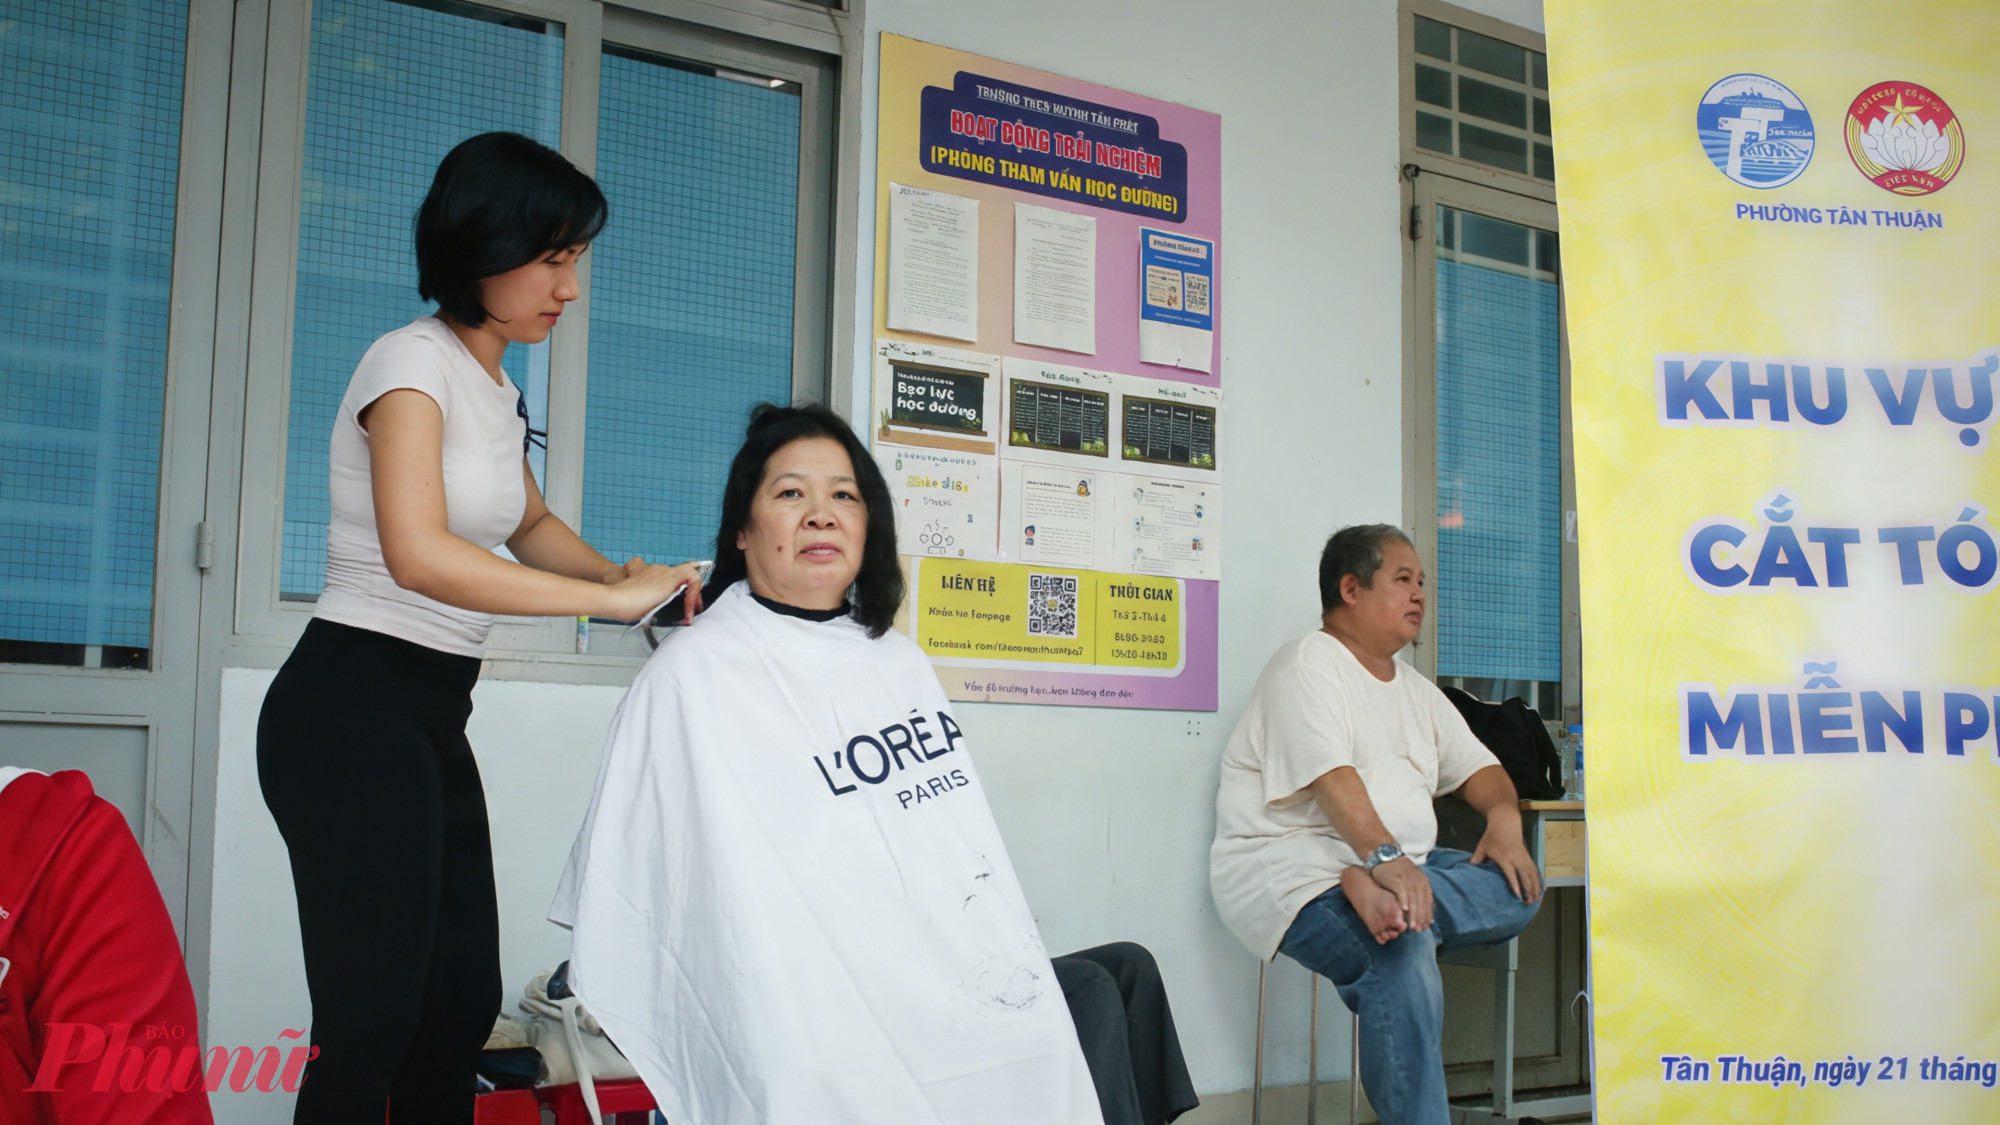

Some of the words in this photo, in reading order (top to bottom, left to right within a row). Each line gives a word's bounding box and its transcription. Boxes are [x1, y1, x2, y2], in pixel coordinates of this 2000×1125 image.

[999, 159, 1045, 185] THAM
[1736, 203, 1822, 224] PHƯỜNG
[1826, 206, 1867, 226] TÂN
[1871, 210, 1944, 231] THUẬN
[1663, 360, 1849, 426] KHU
[1689, 494, 1861, 588] CẮT
[1878, 507, 2000, 588] TÓ
[1686, 661, 1925, 756] MIỄN
[1943, 691, 2000, 758] P
[895, 769, 970, 809] PARIS
[1661, 1056, 1709, 1082] Tân
[1718, 1056, 1806, 1087] Thuận,
[1813, 1055, 1871, 1087] ngày
[1877, 1056, 1908, 1081] 21
[1920, 1056, 1998, 1087] tháng
